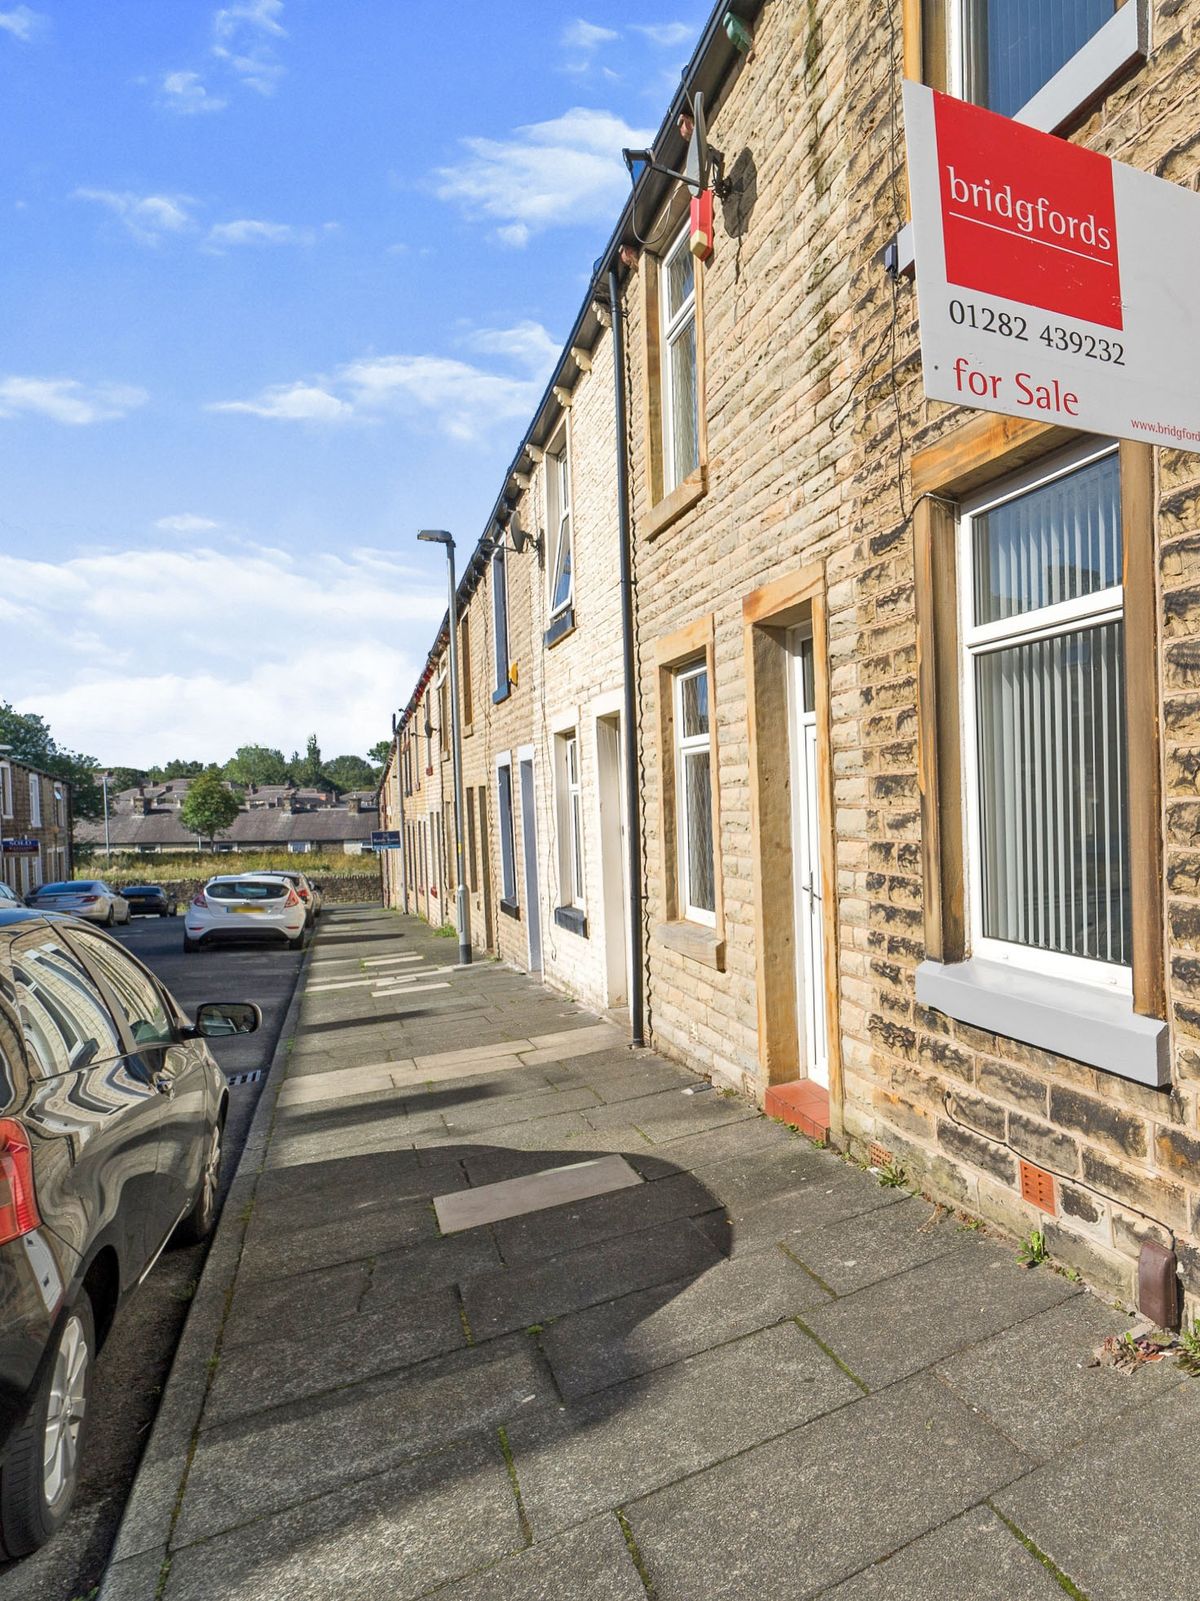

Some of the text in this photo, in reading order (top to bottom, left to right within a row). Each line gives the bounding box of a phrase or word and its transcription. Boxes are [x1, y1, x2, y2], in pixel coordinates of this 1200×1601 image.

[947, 166, 1110, 250] bridgfords
[949, 300, 1126, 366] 01282 439232
[953, 358, 1079, 416] for Sale
